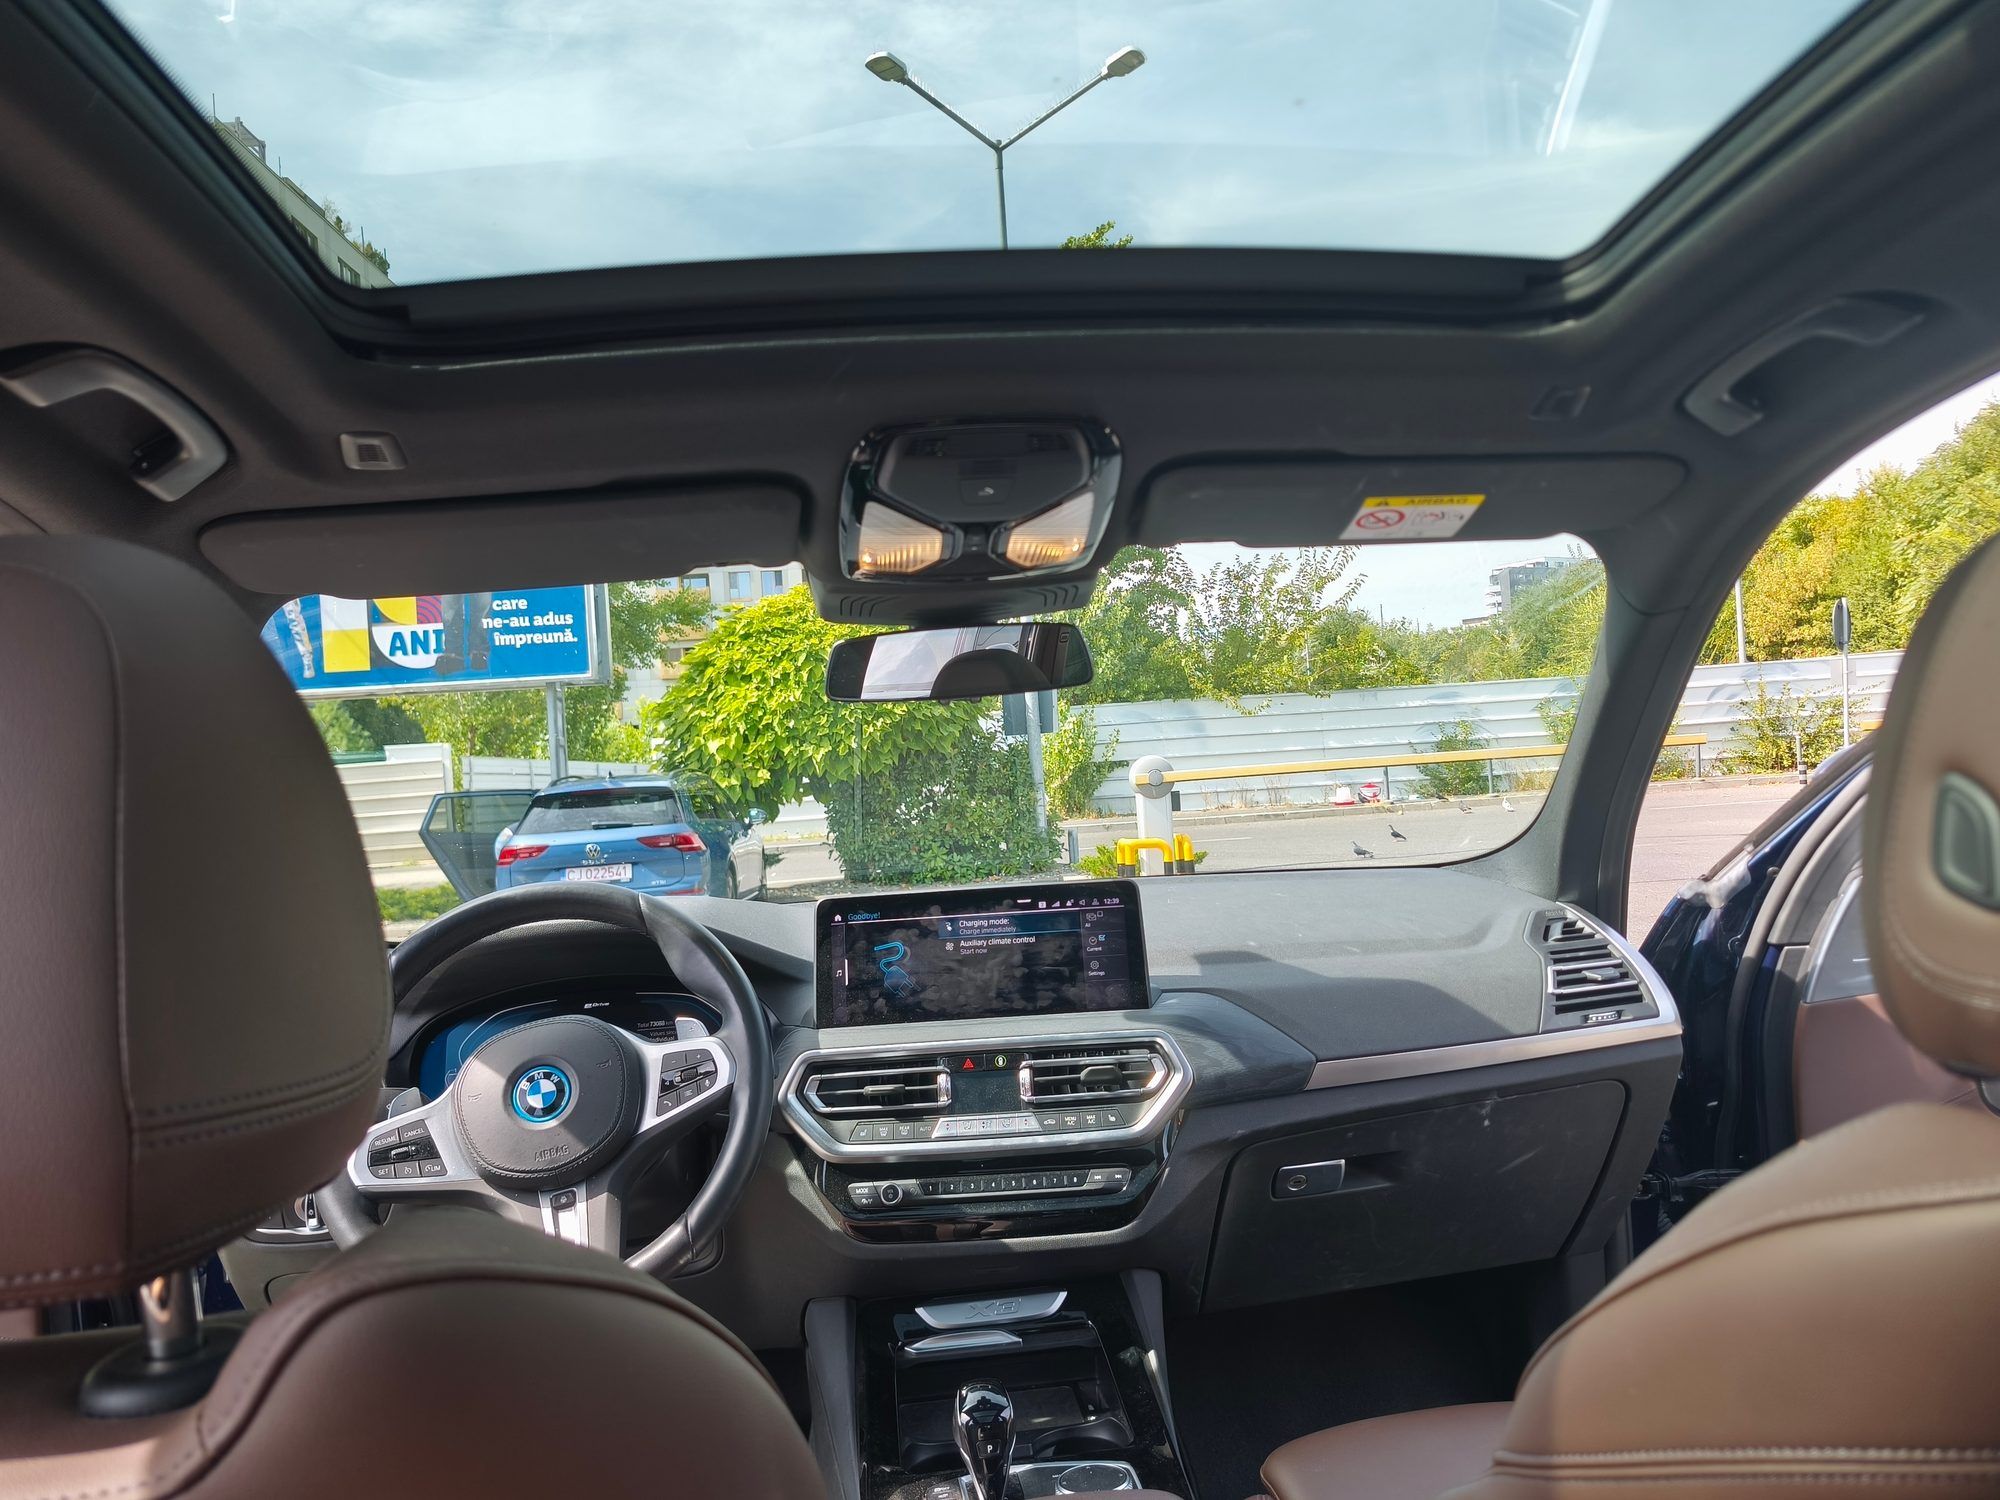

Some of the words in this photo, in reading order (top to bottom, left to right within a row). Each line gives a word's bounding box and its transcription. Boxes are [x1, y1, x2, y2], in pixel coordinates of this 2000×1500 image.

[492, 598, 528, 611] care
[481, 615, 531, 629] ne-au
[533, 611, 574, 626] adus
[493, 628, 578, 648] împreună.
[847, 911, 881, 920] Goodbye!
[959, 919, 988, 928] Charging
[989, 917, 1010, 925] mode:
[959, 928, 981, 936] Charge
[981, 926, 1017, 934] immediately
[960, 938, 988, 947] Auxiliary
[988, 937, 1012, 946] climate
[1012, 936, 1036, 944] control
[637, 1021, 650, 1029] Total
[521, 1072, 560, 1090] BMW
[403, 1126, 426, 1138] CANCEL
[534, 1143, 569, 1162] AIRBAG
[987, 1445, 993, 1454] P
